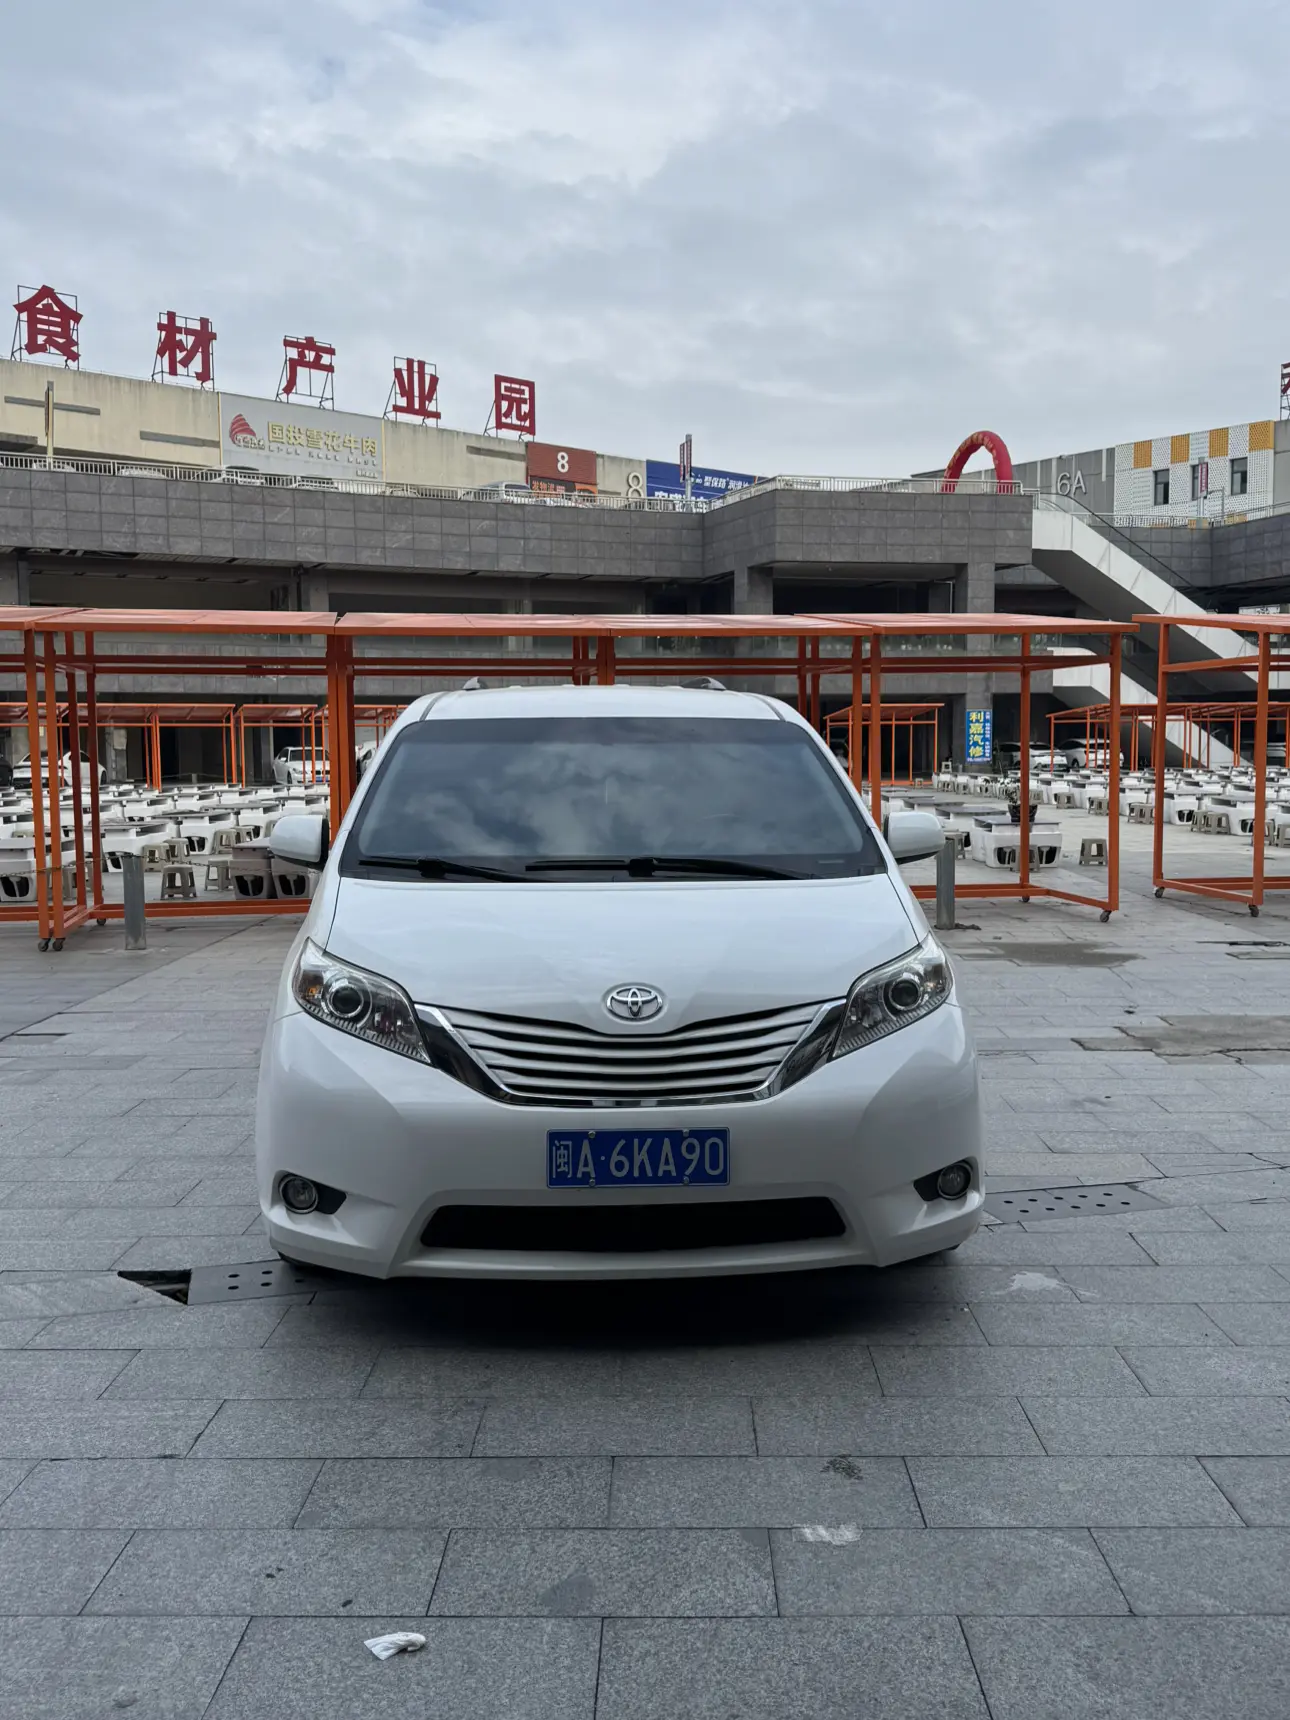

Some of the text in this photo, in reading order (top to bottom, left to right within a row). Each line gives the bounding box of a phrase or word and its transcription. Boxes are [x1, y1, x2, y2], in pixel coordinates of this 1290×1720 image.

[13, 284, 535, 436] 食材产业园
[268, 421, 378, 457] 国投雪花牛肉
[557, 451, 569, 473] 8
[626, 472, 644, 501] 8
[1057, 469, 1087, 497] 6A
